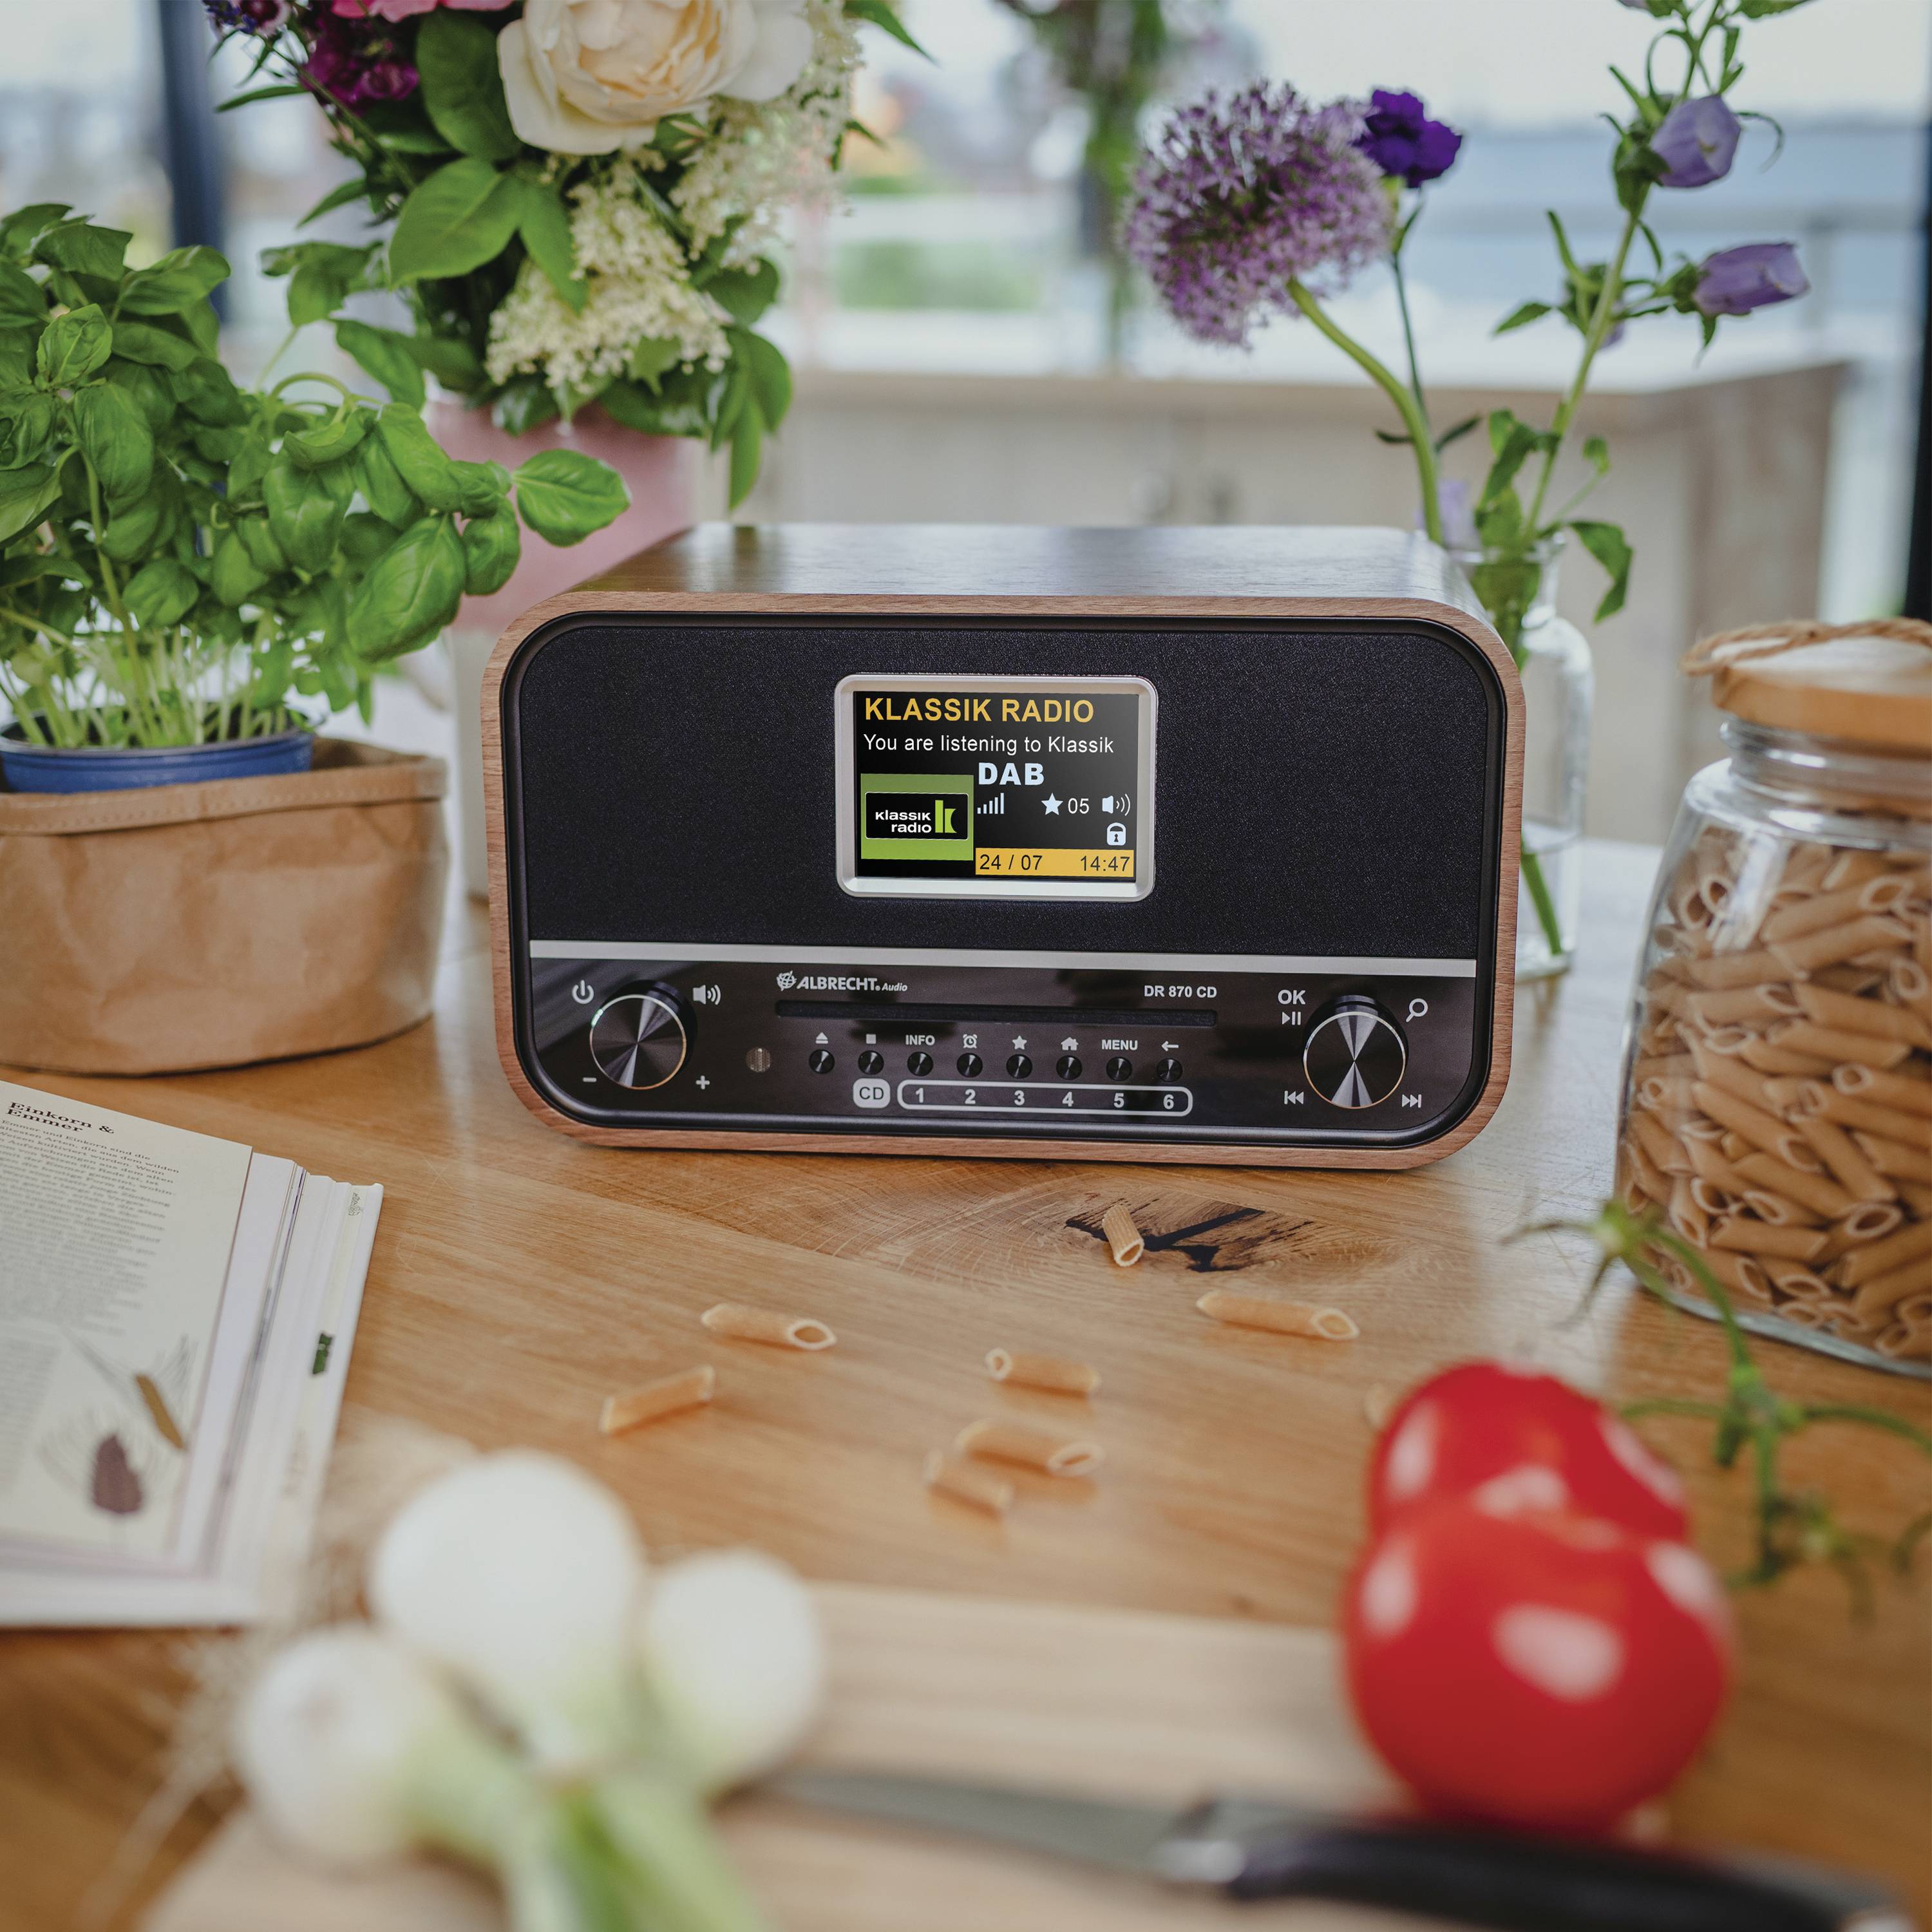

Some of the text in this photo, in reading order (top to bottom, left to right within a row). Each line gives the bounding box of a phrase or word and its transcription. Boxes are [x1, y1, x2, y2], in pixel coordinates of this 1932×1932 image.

[865, 697, 1095, 723] KLASSIK RADIO
[863, 734, 1115, 756] You are listening to Klassik
[978, 762, 1045, 786] DAB
[1067, 797, 1090, 815] 05
[891, 822, 933, 834] radio
[979, 853, 1002, 871] 24
[1020, 854, 1043, 871] 07
[1080, 855, 1131, 872] 14:47
[881, 982, 909, 992] Audio
[1144, 985, 1218, 999] DR 870 CD
[1277, 989, 1306, 1005] OK
[905, 1034, 936, 1046] INFO
[1101, 1039, 1139, 1051] MENU
[858, 1086, 884, 1101] CD
[914, 1087, 1175, 1110] 1 2 3 4 5 6
[6, 1108, 83, 1132] Emmer
[11, 1101, 114, 1134] Einkorn &
[2, 1120, 41, 1132] Emmer
[66, 1135, 107, 1149] Einkorn
[110, 1147, 131, 1155] sind
[38, 1140, 87, 1155] kultiviert
[136, 1164, 165, 1175] Wenn
[120, 1155, 142, 1164] dem
[146, 1162, 179, 1173] wilden
